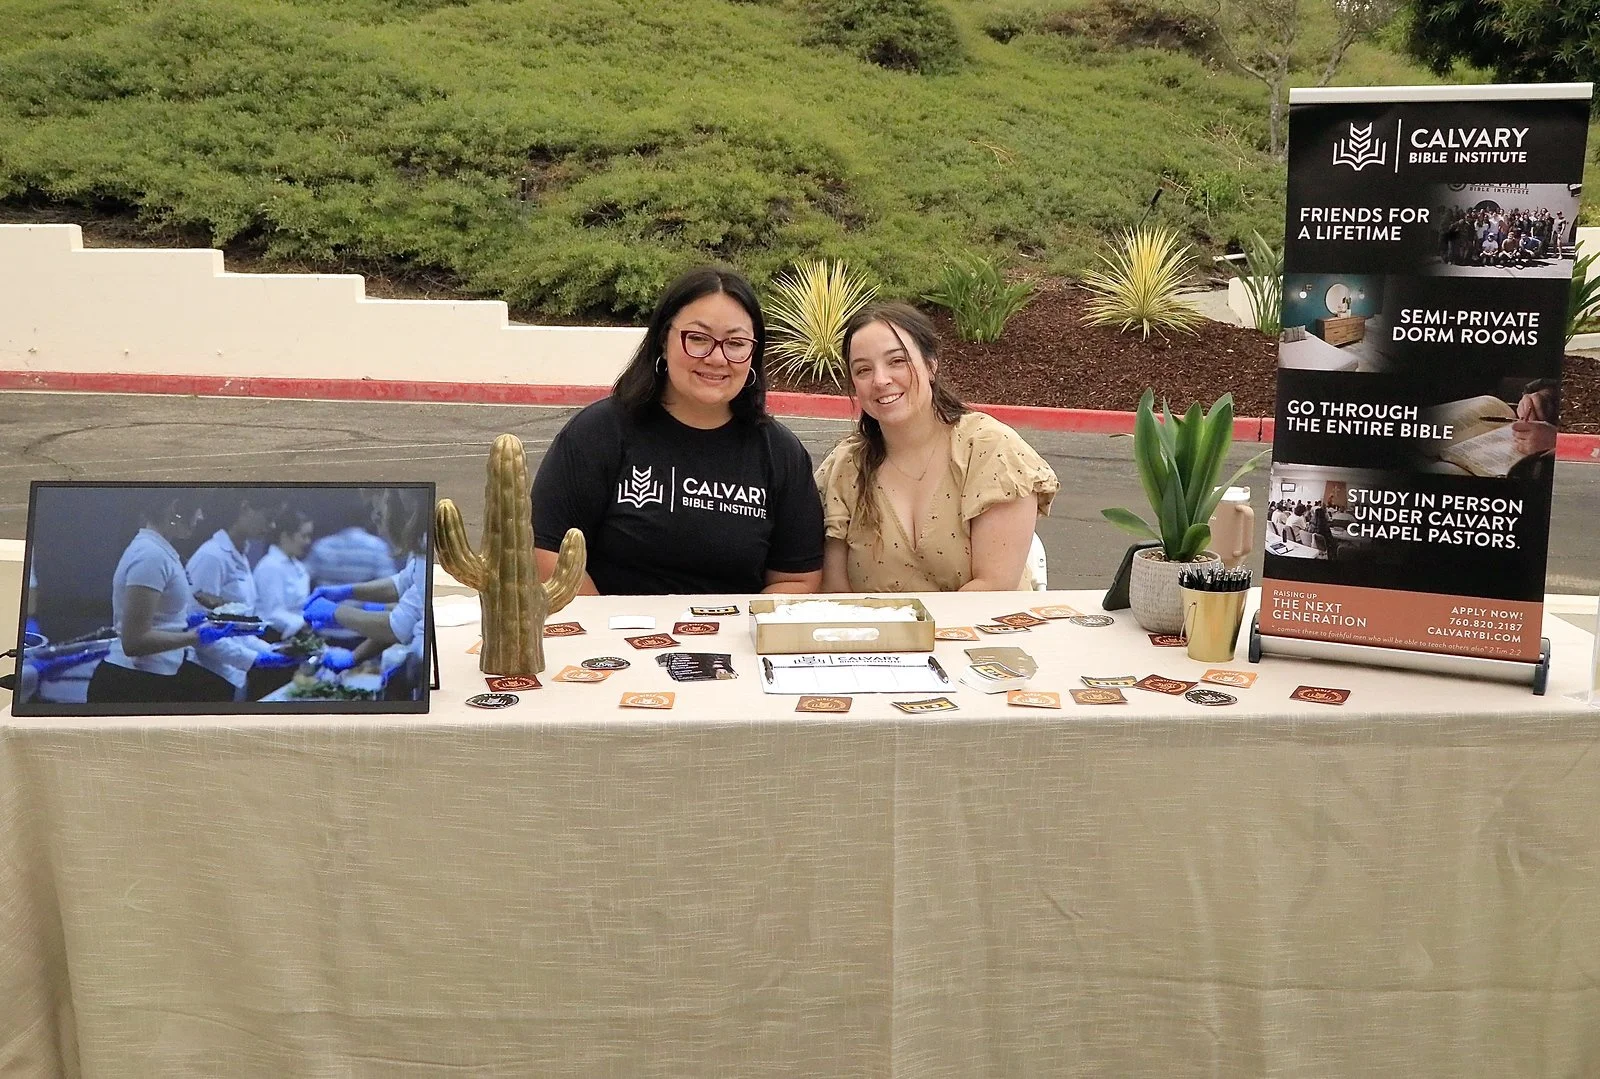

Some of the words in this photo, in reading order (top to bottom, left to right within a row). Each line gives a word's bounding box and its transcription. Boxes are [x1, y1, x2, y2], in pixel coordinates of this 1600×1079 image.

[1410, 127, 1529, 149] CALVARY
[1408, 152, 1448, 164] BIBLE
[1454, 151, 1528, 164] INSTITUTE
[1300, 207, 1383, 222] FRIENDS
[1388, 208, 1430, 224] FOR
[1297, 226, 1310, 240] A
[1316, 226, 1402, 241] LIFETIME
[1400, 309, 1540, 328] SEMI-PRIVATE
[1392, 327, 1453, 343] DORM
[1460, 329, 1538, 346] ROOMS
[1287, 400, 1315, 416] GO
[1321, 401, 1418, 421] THROUGH
[1286, 417, 1321, 433] THE
[1326, 419, 1394, 437] ENTIRE
[1400, 422, 1454, 440] BIBLE
[682, 497, 714, 510] BIBLE
[1347, 488, 1410, 507] STUDY
[1415, 492, 1435, 508] IN
[1442, 495, 1523, 515] PERSON
[1354, 506, 1423, 525] UNDER
[1428, 511, 1519, 532] CALVARY
[1346, 523, 1422, 542] CHAPEL
[1428, 528, 1521, 549] PASTORS.
[1273, 590, 1305, 599] RAISING
[1273, 598, 1300, 610] THE
[1305, 601, 1342, 614] NEXT
[1451, 606, 1487, 617] APPLY
[1490, 609, 1523, 620] NOW!
[1272, 609, 1367, 628] GENERATION
[1449, 617, 1523, 632] 760.820.2187
[1302, 627, 1319, 636] these
[1328, 630, 1352, 639] faithful
[1368, 634, 1382, 642] who
[1427, 626, 1521, 643] CALVARYBI.COM
